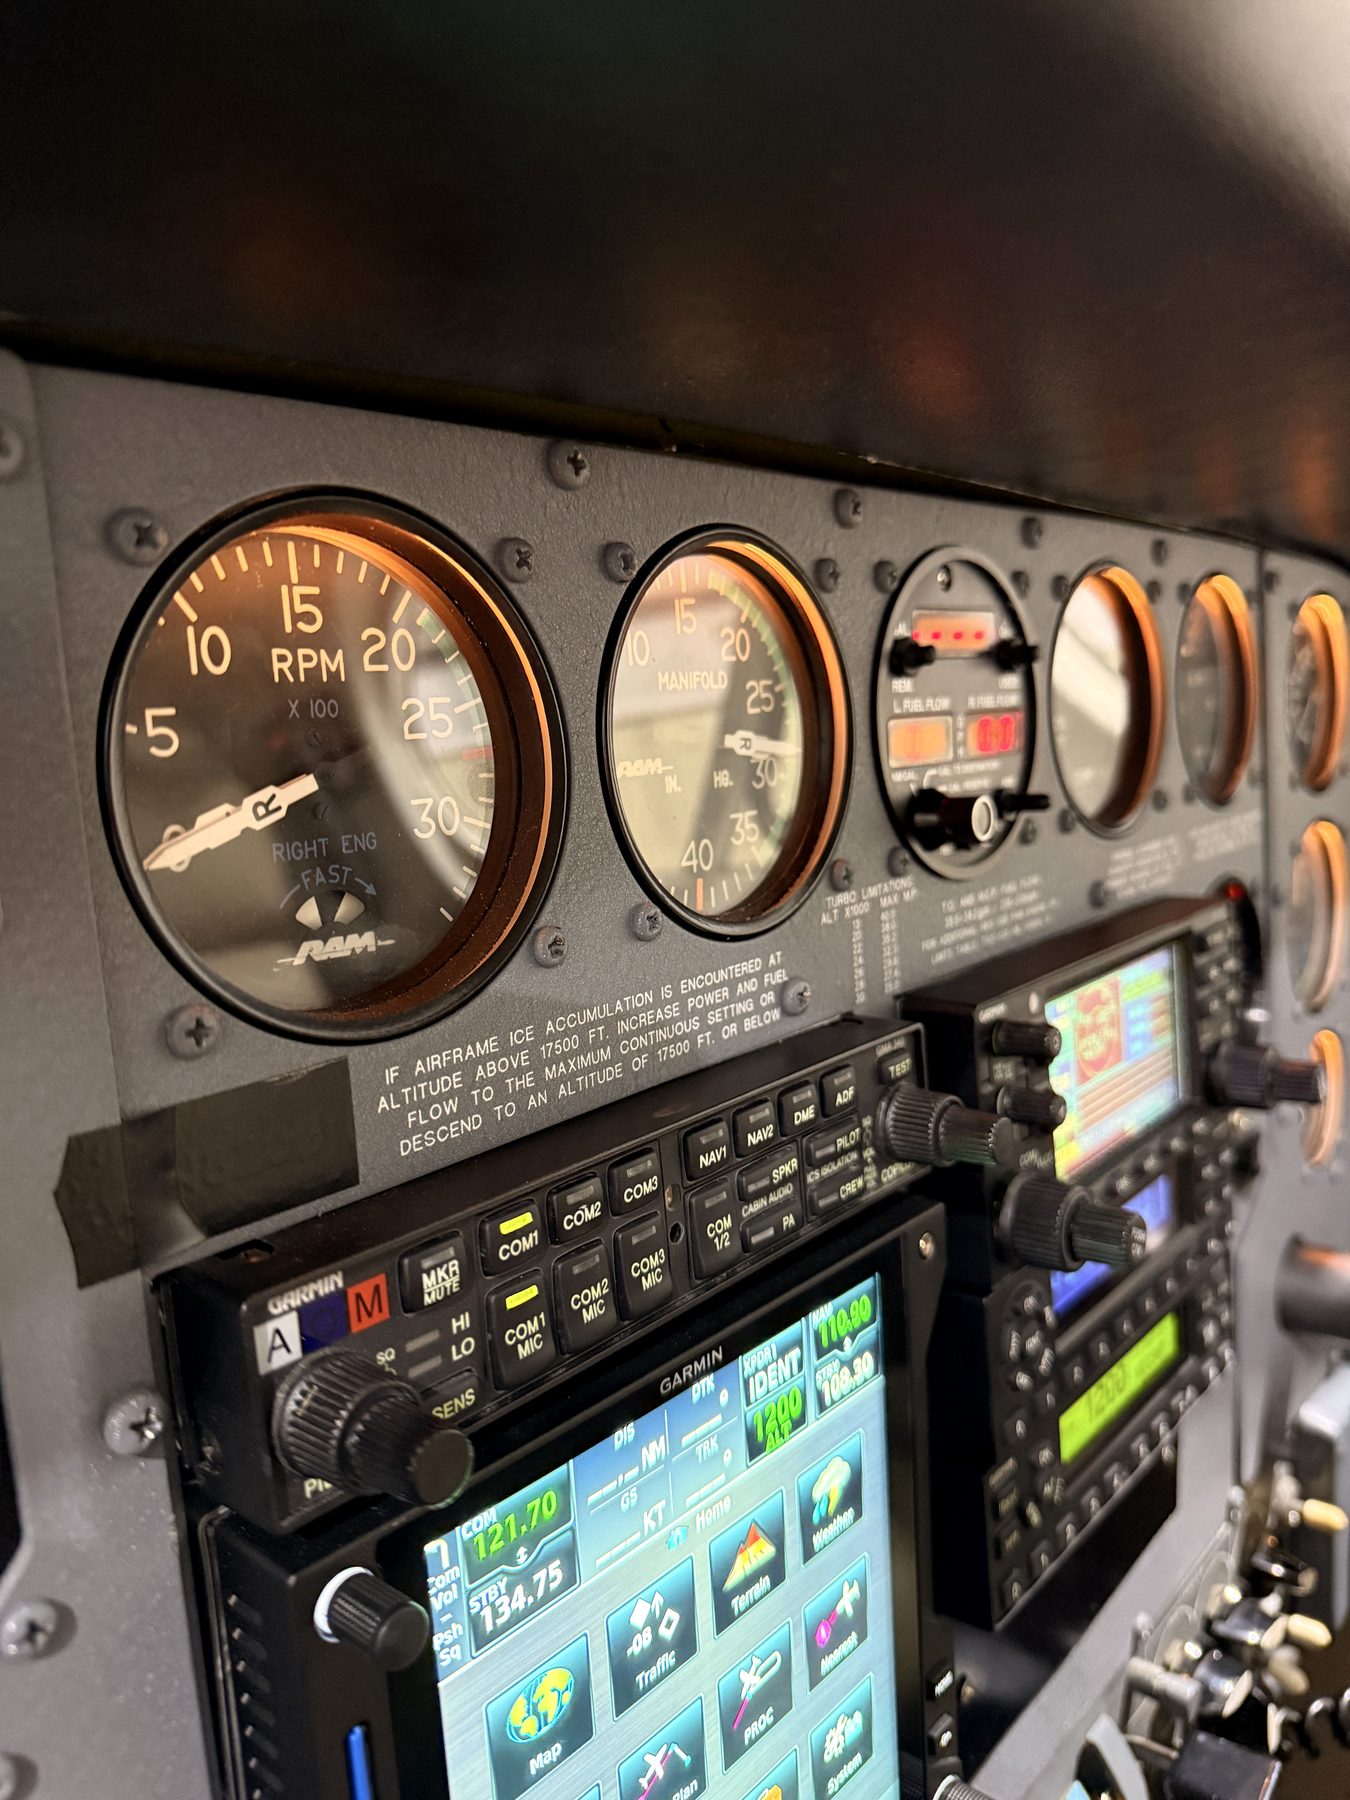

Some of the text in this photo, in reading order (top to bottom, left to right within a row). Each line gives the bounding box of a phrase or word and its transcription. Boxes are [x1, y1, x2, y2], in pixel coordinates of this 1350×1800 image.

[282, 585, 323, 633] 15
[674, 598, 697, 634] 15
[187, 624, 232, 676] 10
[360, 628, 416, 672] 20
[625, 629, 650, 667] 10
[720, 628, 751, 662] 20
[271, 648, 345, 682] RPM
[658, 670, 728, 692] MANIFOLD
[288, 700, 339, 718] X 100
[746, 680, 775, 714] 25
[145, 707, 180, 758] 5
[402, 697, 453, 740] 25
[739, 737, 752, 750] R
[751, 759, 778, 789] 30
[252, 793, 282, 821] R
[410, 796, 460, 839] 30
[730, 810, 760, 846] 35
[272, 832, 377, 863] RIGHT ENG
[681, 839, 713, 873] 40
[301, 864, 352, 890] FAST
[825, 876, 914, 909] TURBO LIMITATIONS
[820, 909, 839, 926] ALT
[880, 893, 898, 908] MAX
[292, 931, 376, 965] RAM
[384, 951, 782, 1085] IF AIRFRAME ICE ACCUMULATION IS ENCOUNTERED AT
[377, 968, 789, 1113] ALTITUDE ABOVE 17500 FT. INCREASE POWER AND FUEL
[408, 991, 776, 1128] FLOW TO THE MAXIMUM CONTINUOUS SETTING OR
[888, 1058, 912, 1079] TEST
[399, 1007, 781, 1156] DESCEND TO AN ALTITUDE OF 17500 FT. OR BELOW
[835, 1086, 855, 1107] ADF
[794, 1104, 816, 1126] DME
[747, 1124, 774, 1147] NAV2
[836, 1127, 860, 1152] PILOT
[699, 1146, 727, 1169] NAV1
[772, 1157, 798, 1185] SPKR
[806, 1168, 820, 1184] ICS
[820, 1150, 858, 1177] ISOLATION
[623, 1175, 659, 1203] COM3
[741, 1182, 793, 1218] CABIN AUDIO
[840, 1174, 864, 1200] CREW
[563, 1201, 602, 1230] COM2
[706, 1213, 732, 1239] COM
[782, 1213, 795, 1232] PA
[498, 1230, 539, 1261] COM1
[713, 1232, 731, 1252] 1/2
[421, 1259, 460, 1290] MKR
[631, 1248, 666, 1279] COM3
[641, 1268, 663, 1292] MIC
[267, 1270, 344, 1315] GARMIN
[423, 1281, 460, 1306] MUTE
[570, 1278, 610, 1311] COM2
[268, 1283, 382, 1363] A M
[451, 1311, 471, 1335] HI
[504, 1312, 546, 1345] COM1
[581, 1299, 606, 1325] MIC
[812, 1302, 834, 1330] NAV
[819, 1294, 871, 1348] 110.90
[376, 1347, 396, 1365] SQ
[451, 1337, 475, 1361] LO
[517, 1333, 544, 1360] MIC
[660, 1345, 723, 1396] GARMIN
[748, 1347, 801, 1404] IDENT
[816, 1359, 840, 1390] STBY
[822, 1351, 875, 1407] 108.30
[431, 1388, 476, 1420] SENS
[691, 1373, 715, 1404] DTK
[754, 1385, 803, 1442] 1200
[614, 1422, 635, 1451] DIS
[642, 1434, 665, 1472] NM
[695, 1434, 718, 1464] TRK
[765, 1420, 792, 1455] ALT
[620, 1487, 638, 1512] GS
[695, 1495, 731, 1534] Home
[461, 1507, 497, 1539] COM
[474, 1490, 557, 1561] 121.70
[643, 1499, 666, 1536] KT
[430, 1584, 458, 1612] Vol
[469, 1576, 509, 1615] STBY
[480, 1559, 563, 1634] 134.75
[731, 1574, 771, 1617] Terrain
[432, 1622, 464, 1651] Psh
[635, 1650, 676, 1692] Traffic
[744, 1706, 775, 1746] PROC
[529, 1741, 563, 1776] Map
[826, 1752, 863, 1796] System
[672, 1779, 698, 1800] Plan
